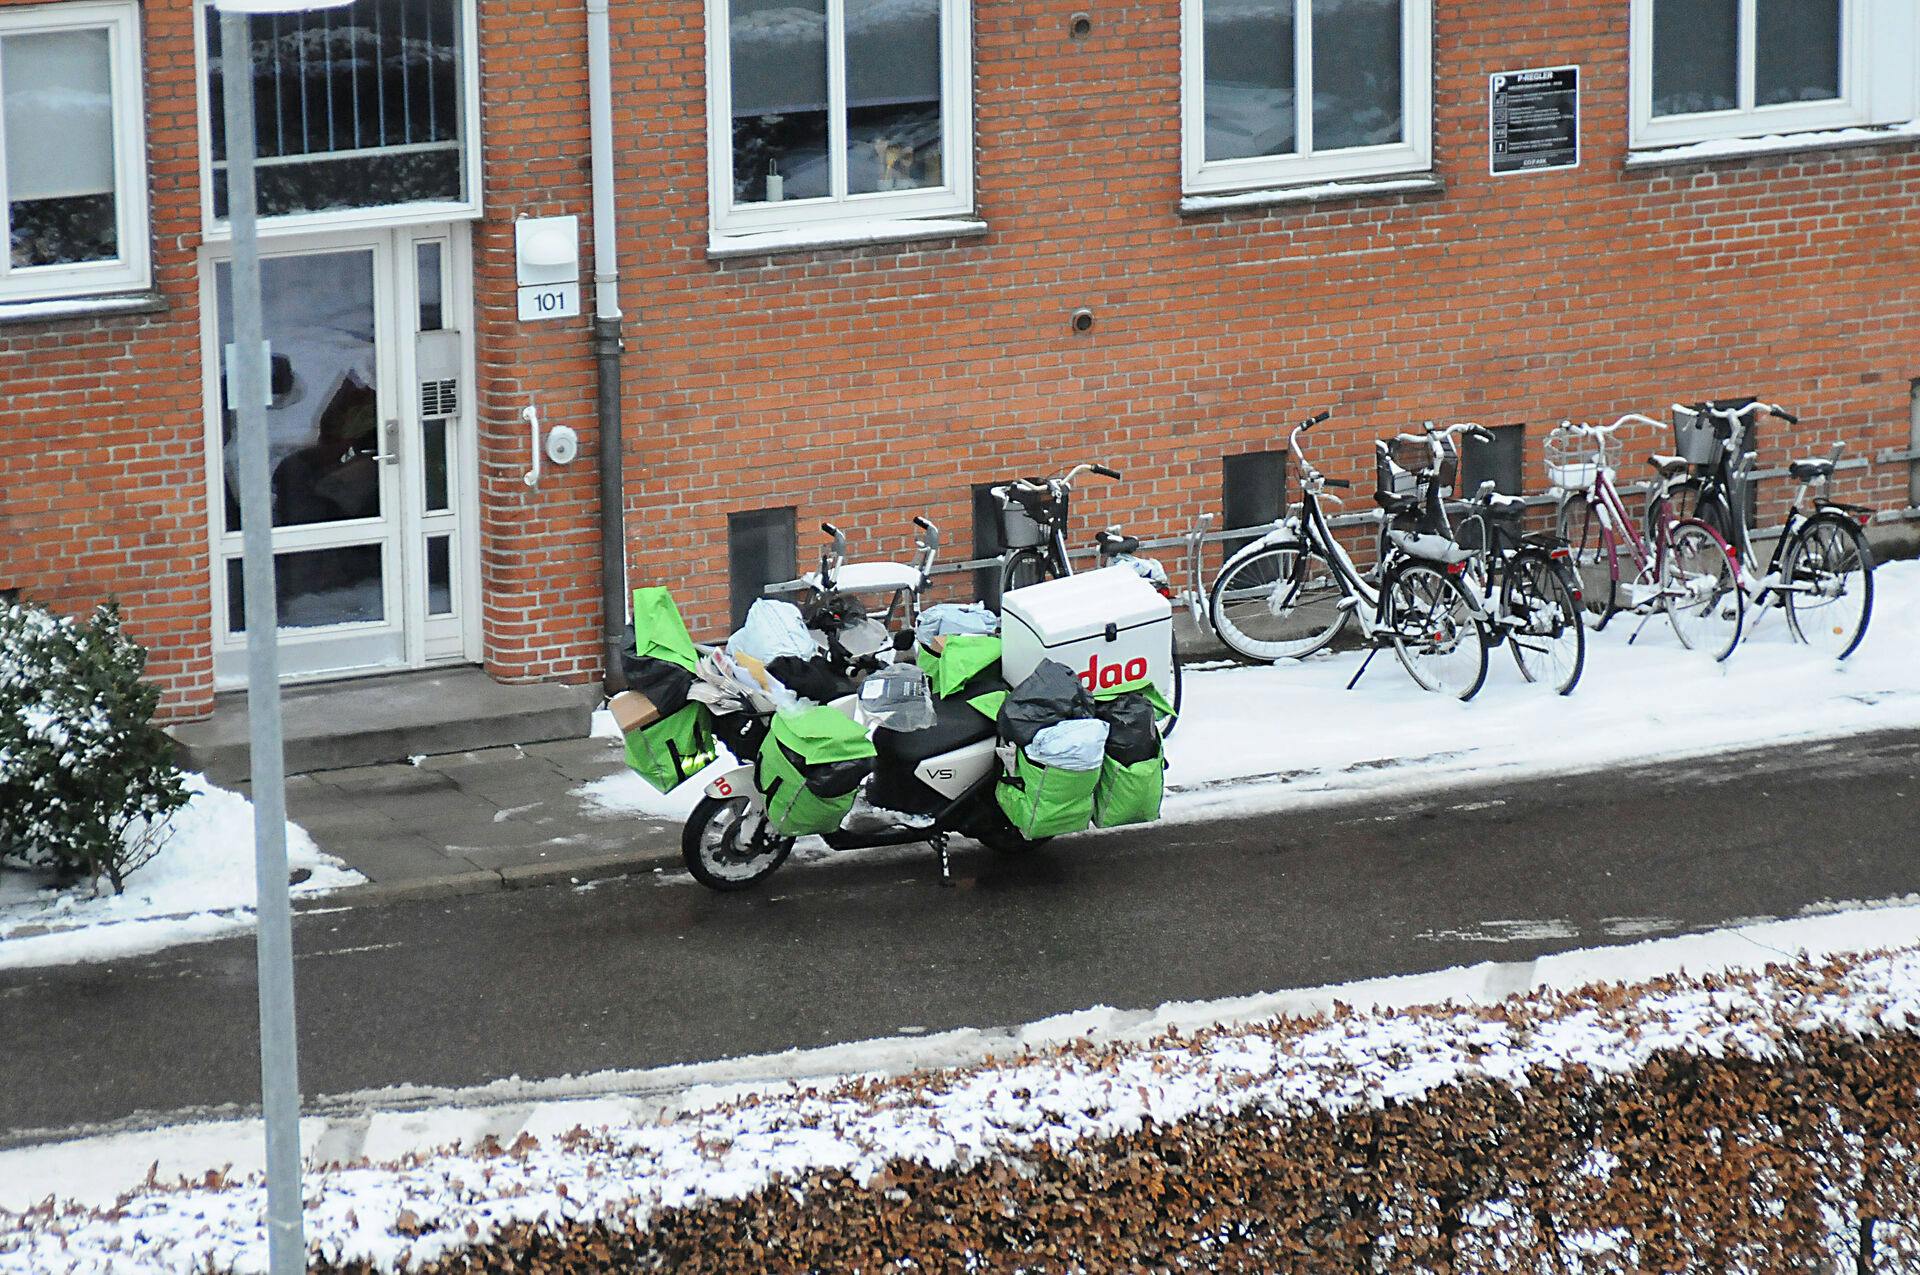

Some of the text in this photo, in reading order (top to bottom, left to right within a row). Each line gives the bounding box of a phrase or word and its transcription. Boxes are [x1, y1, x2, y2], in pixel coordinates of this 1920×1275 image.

[1494, 76, 1506, 93] P
[534, 291, 564, 312] 101
[1077, 654, 1148, 692] dao
